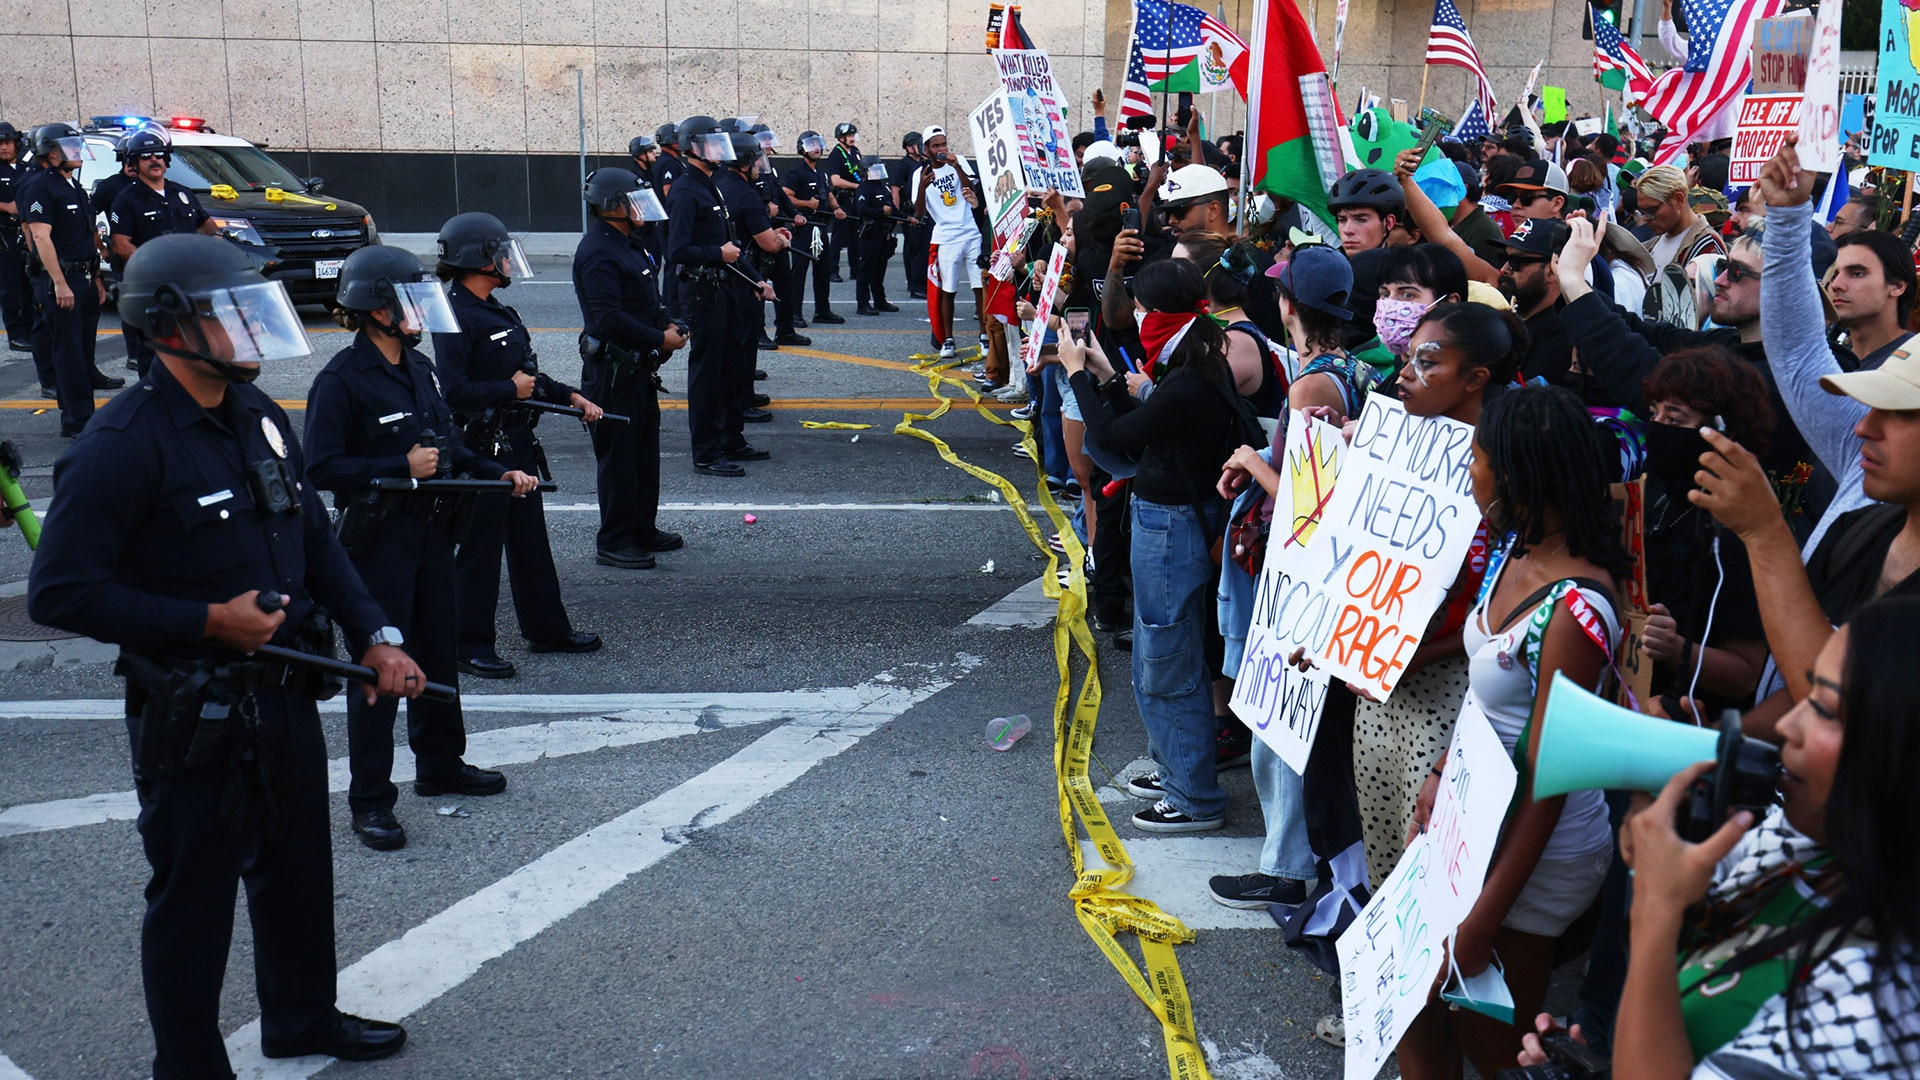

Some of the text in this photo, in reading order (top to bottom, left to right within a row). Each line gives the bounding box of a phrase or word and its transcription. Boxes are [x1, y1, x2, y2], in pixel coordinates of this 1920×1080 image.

[1886, 28, 1896, 52] A
[996, 53, 1049, 77] WHAT KILLED
[1761, 53, 1784, 84] STOP
[1766, 101, 1793, 125] OFF
[1885, 79, 1920, 118] MOR
[976, 97, 1004, 139] YES
[989, 130, 998, 144] ON
[1734, 130, 1798, 159] PROPERT
[1872, 123, 1899, 156] POR
[987, 138, 1008, 177] 50
[1732, 163, 1745, 180] GET
[932, 173, 955, 188] WHAT
[938, 181, 955, 193] THE
[1024, 165, 1043, 188] THE
[1058, 169, 1081, 194] AGE!
[317, 267, 339, 277] 14630
[1348, 473, 1458, 560] NEEDS
[1331, 536, 1422, 623] YOUR
[1275, 582, 1420, 693] COURAGE
[1279, 667, 1328, 744] WAY
[1152, 931, 1172, 941] CRO
[1365, 896, 1388, 951] ALL
[1155, 970, 1167, 987] POLICE
[1376, 944, 1396, 996] THE
[1159, 984, 1171, 996] LINE
